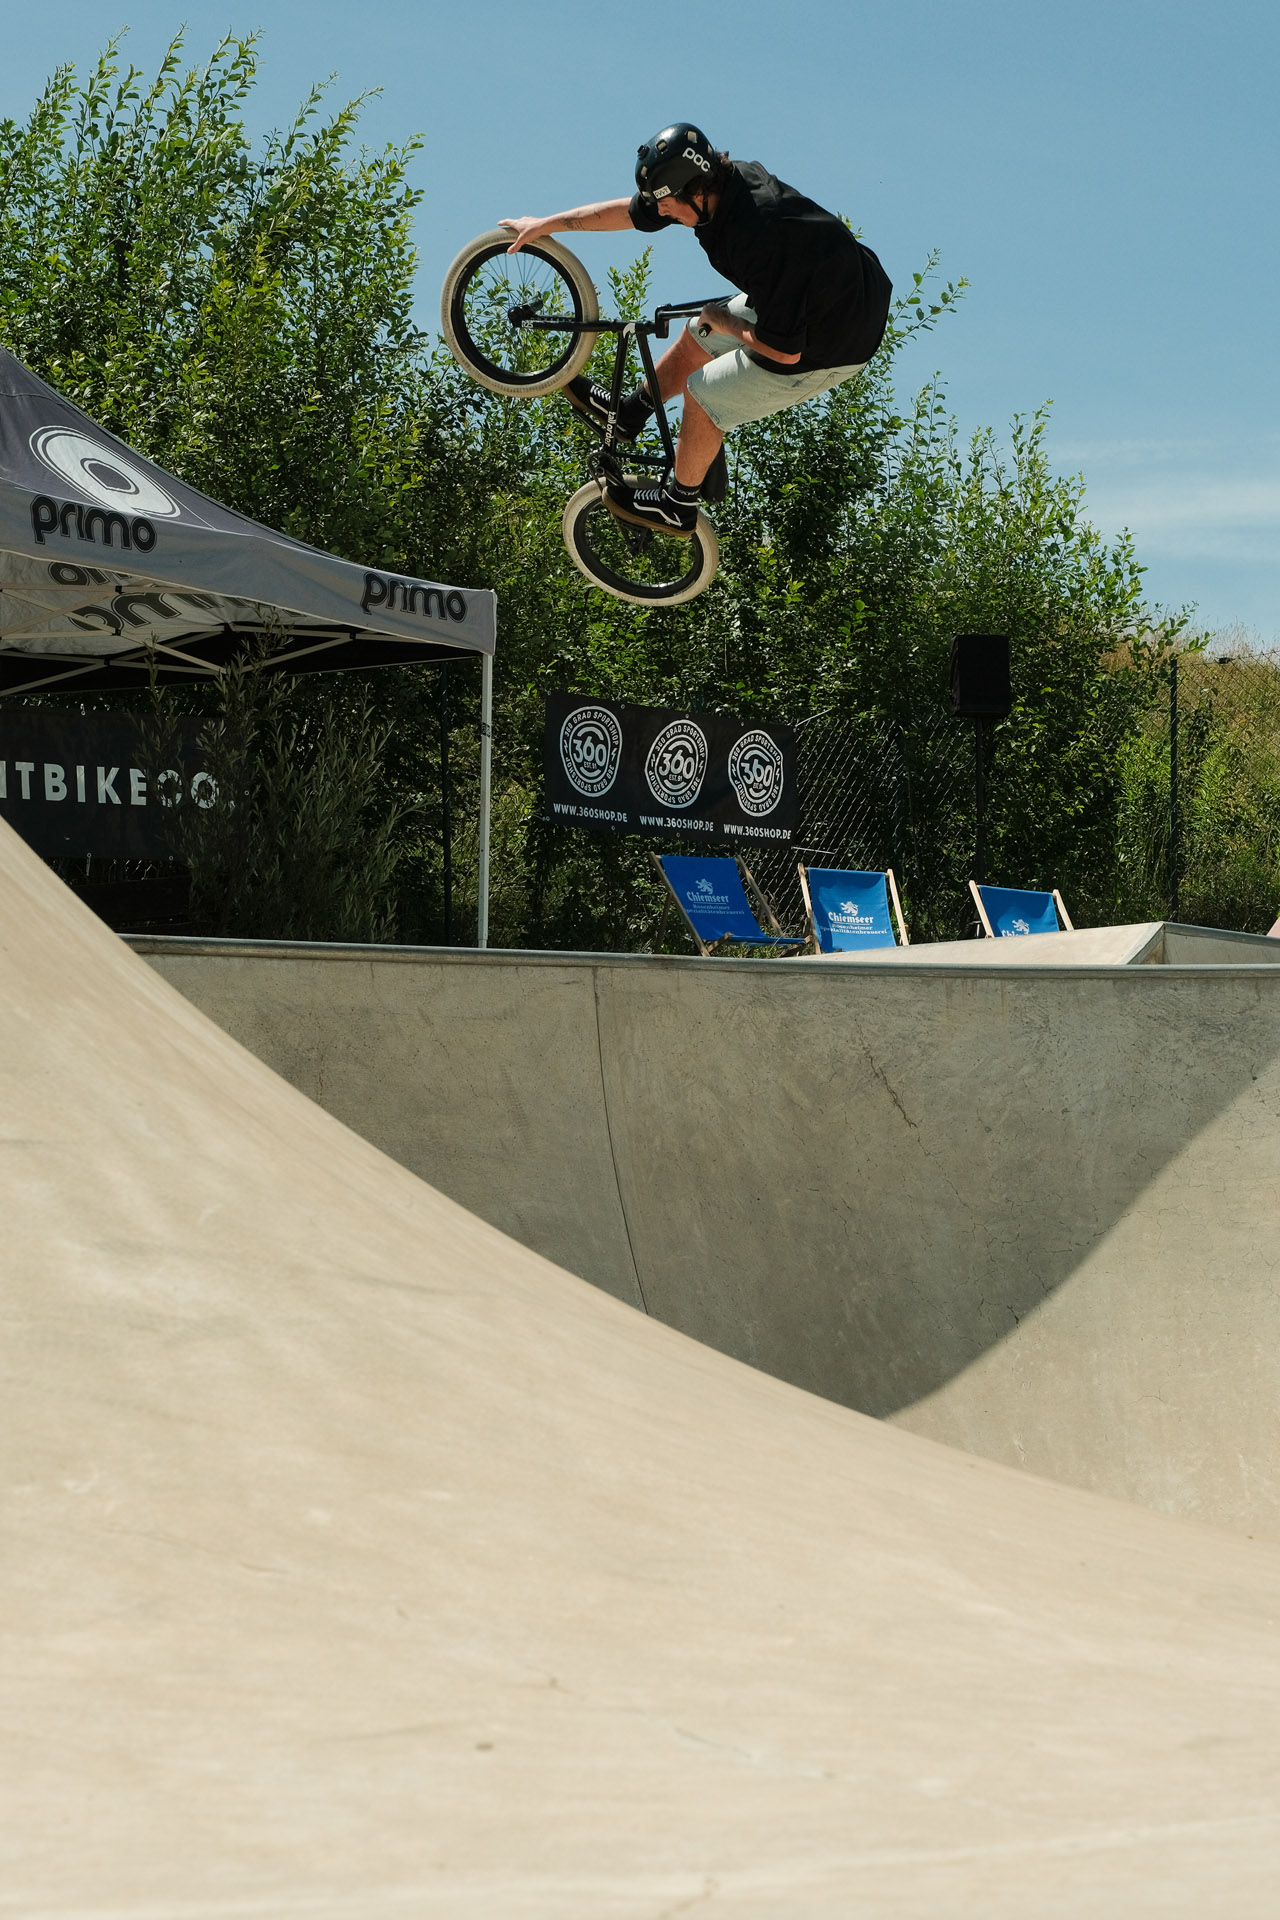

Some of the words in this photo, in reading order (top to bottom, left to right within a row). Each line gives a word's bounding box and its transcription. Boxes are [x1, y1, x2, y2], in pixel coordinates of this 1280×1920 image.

[682, 147, 711, 172] POC
[30, 494, 157, 553] primo
[360, 571, 468, 623] primo
[572, 711, 592, 724] GRAD
[593, 711, 619, 746] SPORTSHOP
[665, 725, 682, 739] GRAD
[682, 724, 705, 758] SPORTSHOP
[572, 735, 607, 767] 360
[658, 749, 695, 780] 360
[740, 734, 755, 748] GRAD
[754, 734, 781, 766] SPORTSHOP
[565, 757, 592, 792] SPORTSHOP
[593, 778, 608, 792] GRAD
[648, 770, 676, 804] SPORTSHOP
[740, 758, 773, 787] 360
[677, 790, 693, 804] GRAD
[734, 780, 758, 812] SPORTSHOP
[758, 799, 773, 812] GRAD
[553, 802, 628, 823] WWW.360SHOP.DE
[639, 815, 714, 832] WWW.360SHOP.DE
[723, 823, 792, 840] WWW.360SHOP.DE
[686, 891, 729, 903] Chiemseer
[828, 911, 874, 924] Chiemseer
